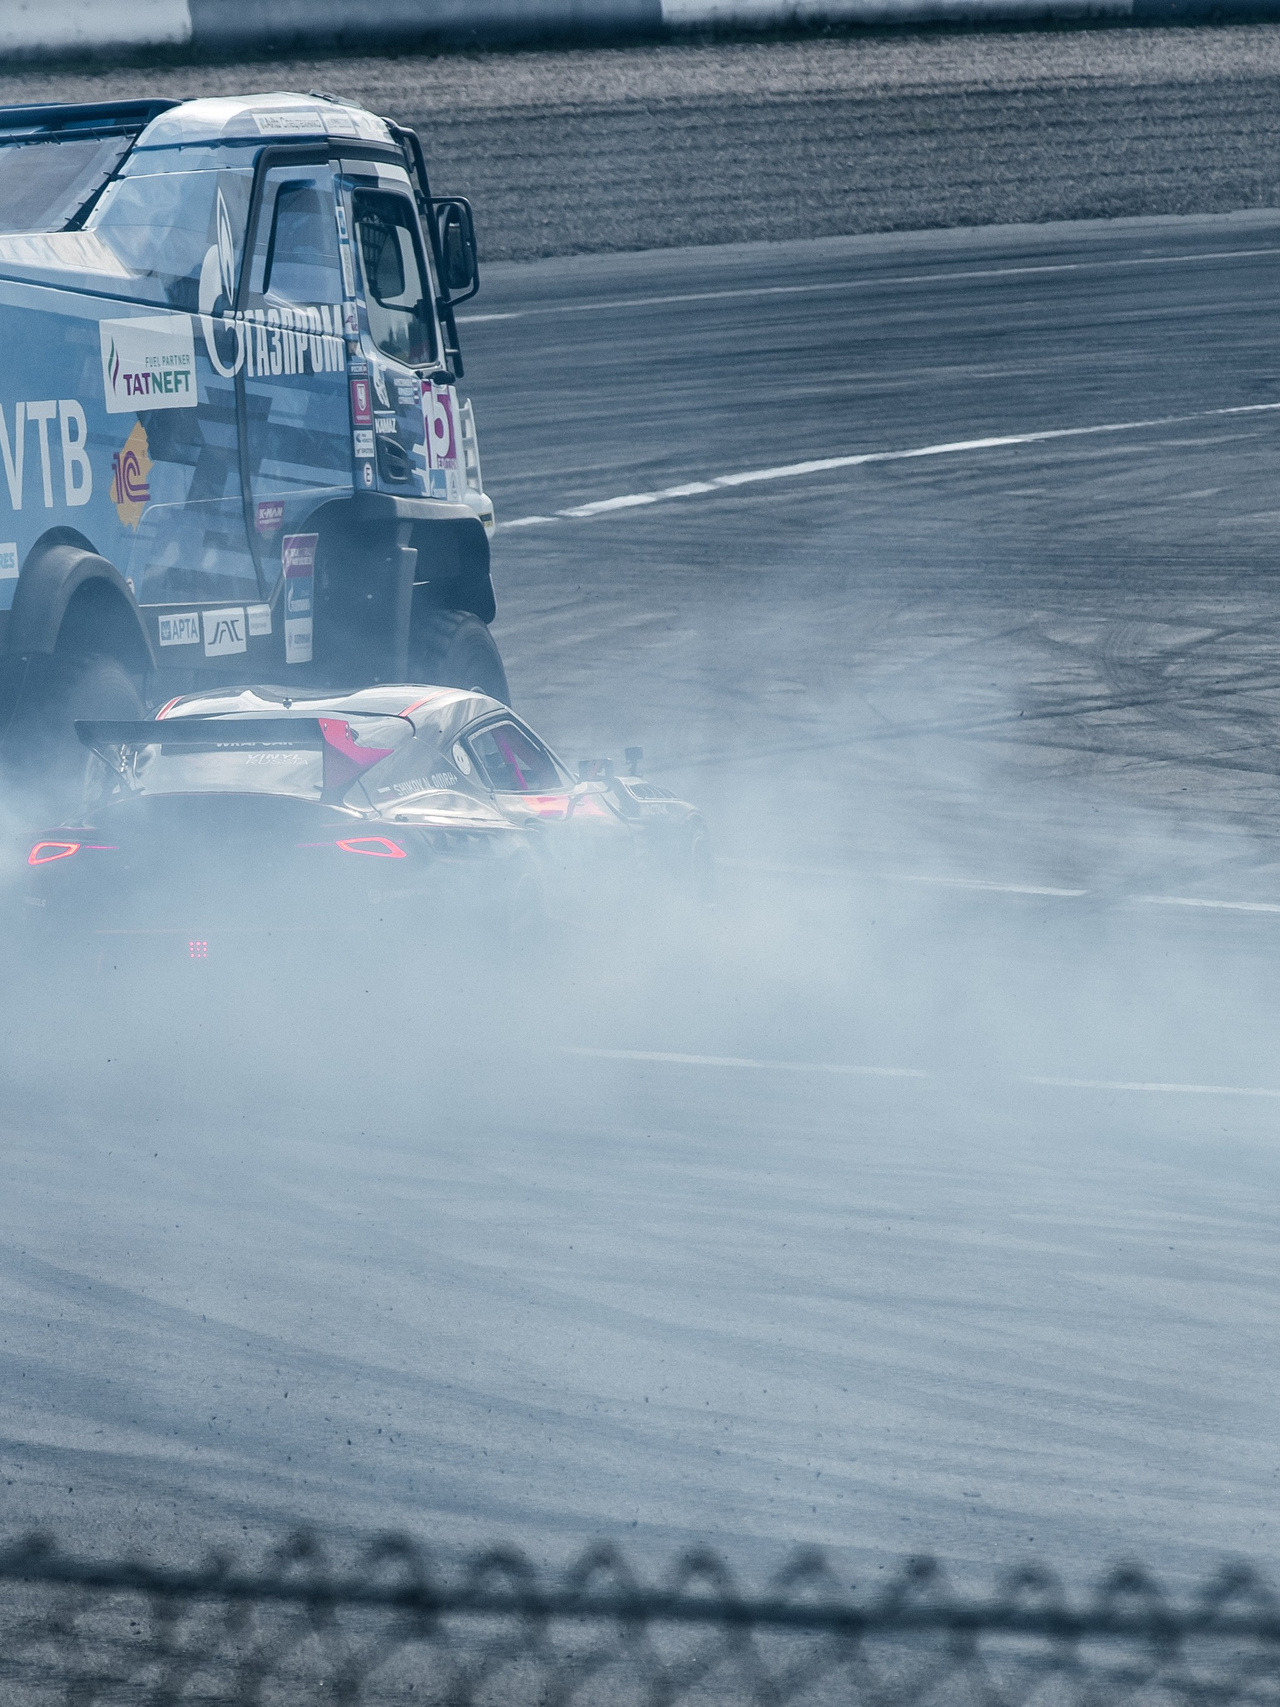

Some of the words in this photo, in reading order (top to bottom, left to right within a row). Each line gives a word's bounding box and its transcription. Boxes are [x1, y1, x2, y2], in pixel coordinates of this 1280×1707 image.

[145, 356, 161, 367] FUEL
[162, 354, 191, 366] PARTNER
[123, 370, 191, 396] TATNEFT
